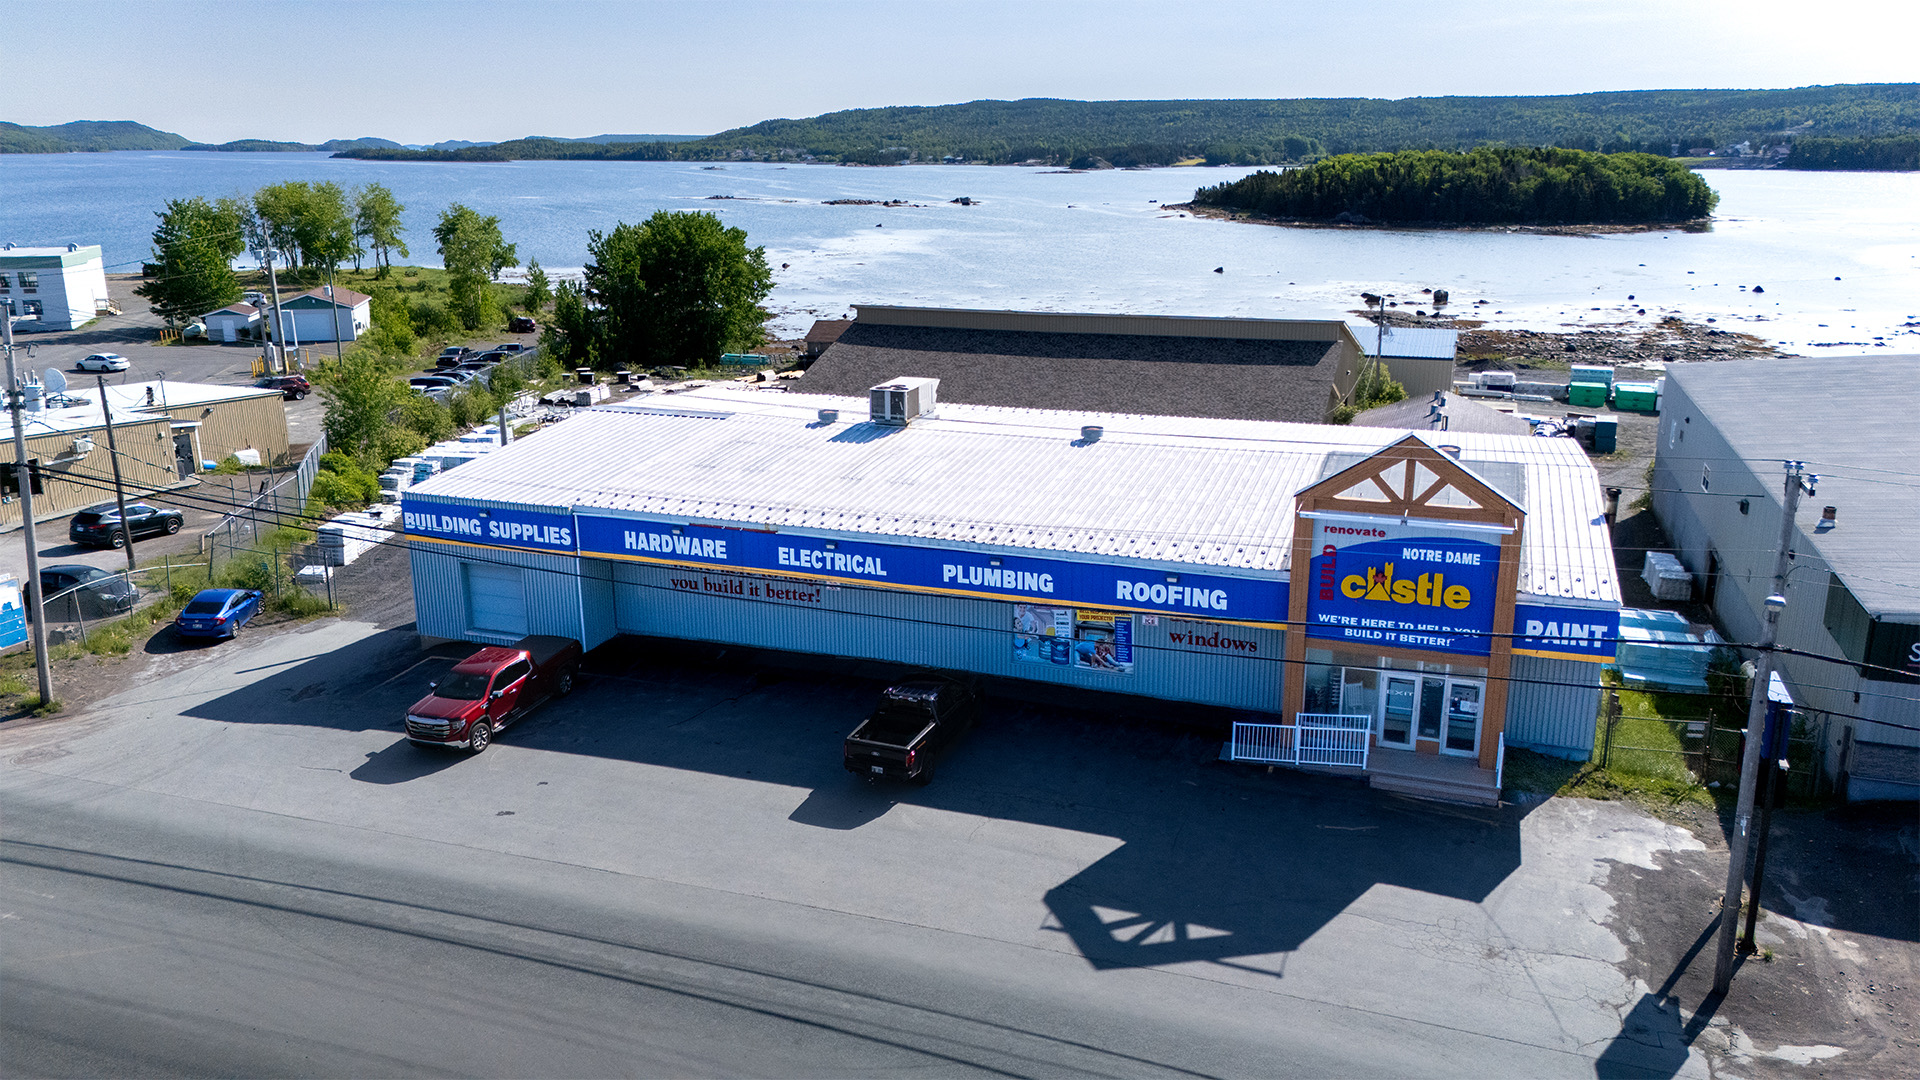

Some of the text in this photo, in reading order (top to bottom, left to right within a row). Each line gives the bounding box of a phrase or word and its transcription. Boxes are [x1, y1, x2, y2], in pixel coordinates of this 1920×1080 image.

[404, 512, 572, 546] BUILDING SUPPLIES
[1324, 525, 1386, 538] renovate
[624, 531, 727, 559] HARDWARE
[1402, 548, 1481, 566] NOTRE DAME
[778, 546, 887, 576] ELECTRICAL
[1319, 544, 1337, 601] BUILD
[670, 578, 698, 590] you
[703, 577, 743, 595] build
[749, 582, 760, 597] it
[765, 583, 821, 603] better!
[943, 564, 1053, 593] PLUMBING
[1340, 562, 1471, 610] castle
[1116, 580, 1228, 611] ROOFING
[1318, 613, 1359, 626] WE'RE
[1361, 618, 1396, 629] HERE
[1398, 622, 1414, 630] TO
[1525, 620, 1608, 648] PAINT
[1169, 630, 1258, 653] windows
[1344, 628, 1452, 647] BUILD IT BETTER!
